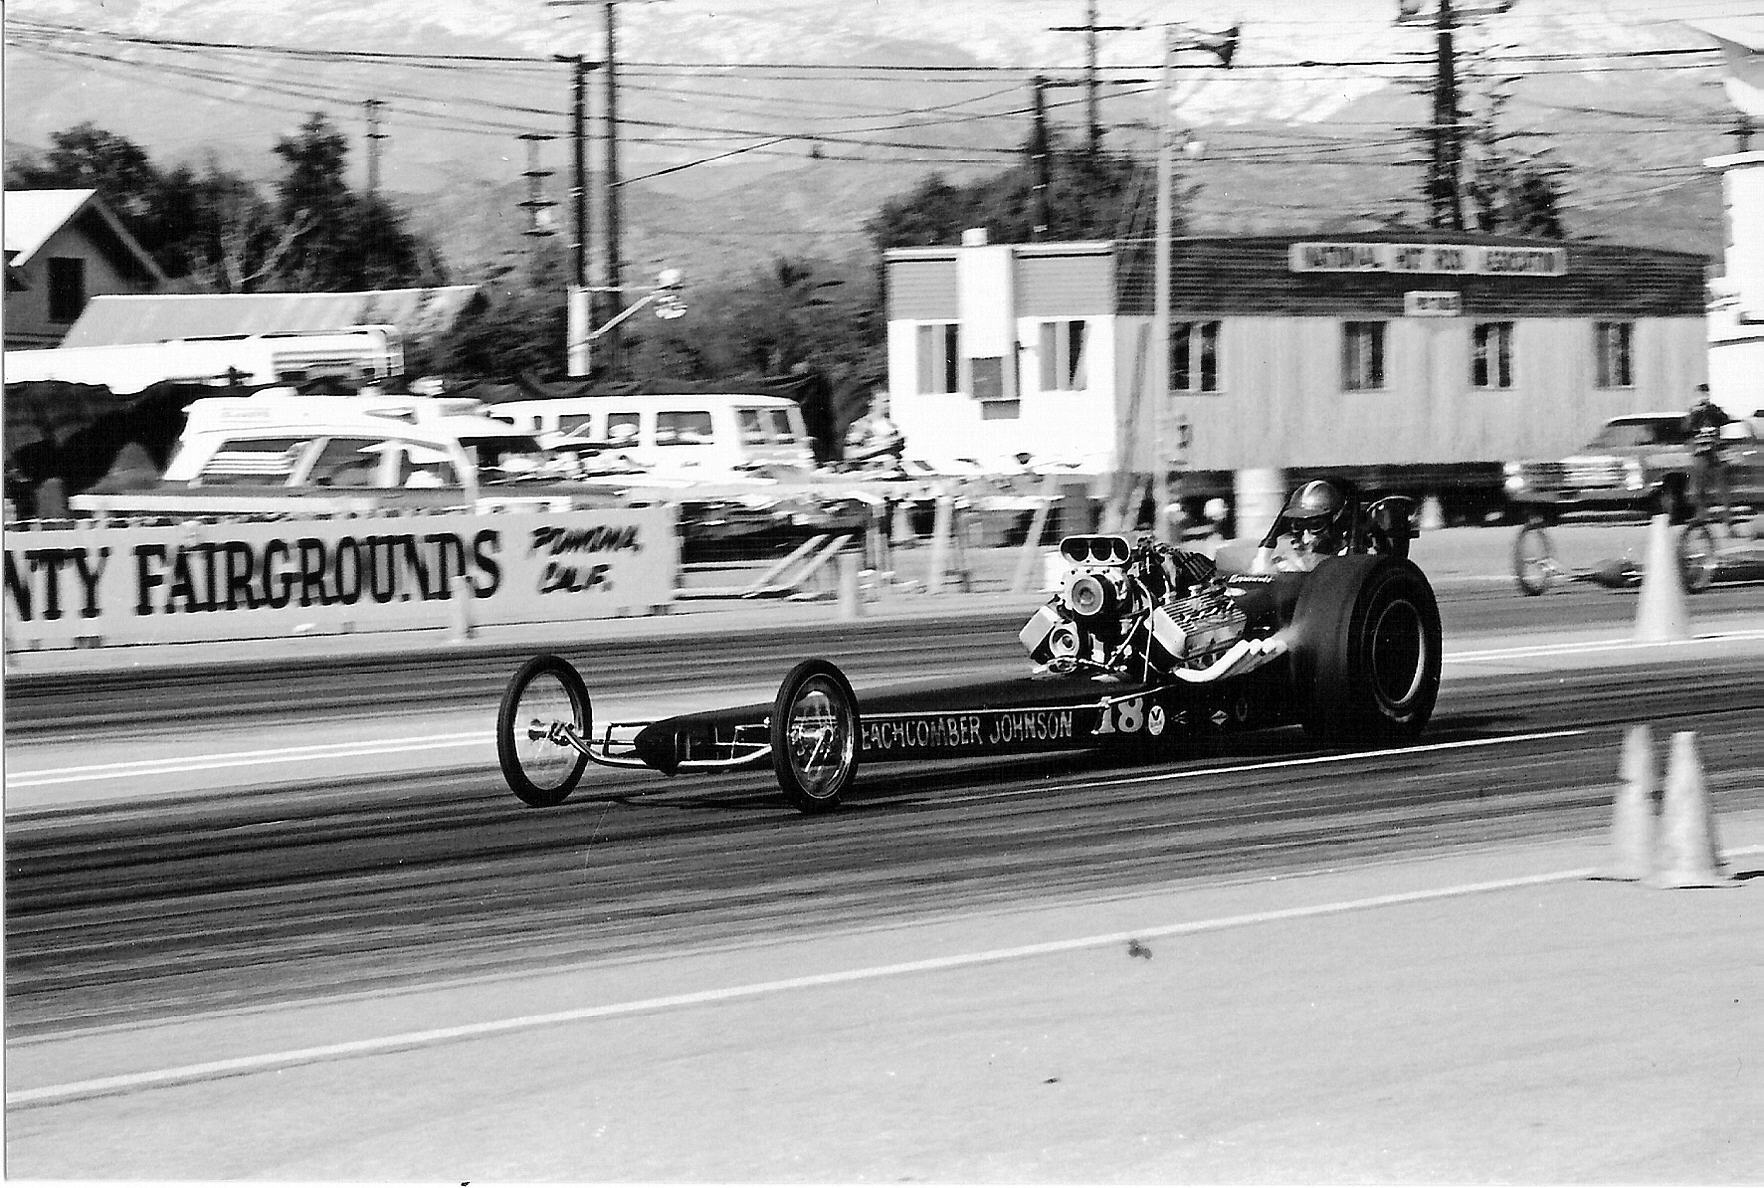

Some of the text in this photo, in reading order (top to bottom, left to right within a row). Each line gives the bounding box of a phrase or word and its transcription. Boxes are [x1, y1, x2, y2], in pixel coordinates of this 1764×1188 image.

[134, 529, 502, 616] FAIRGROUNDS
[860, 715, 983, 750] EACHCOMBER
[989, 711, 1073, 744] JOHNSON
[1092, 696, 1144, 734] 18
